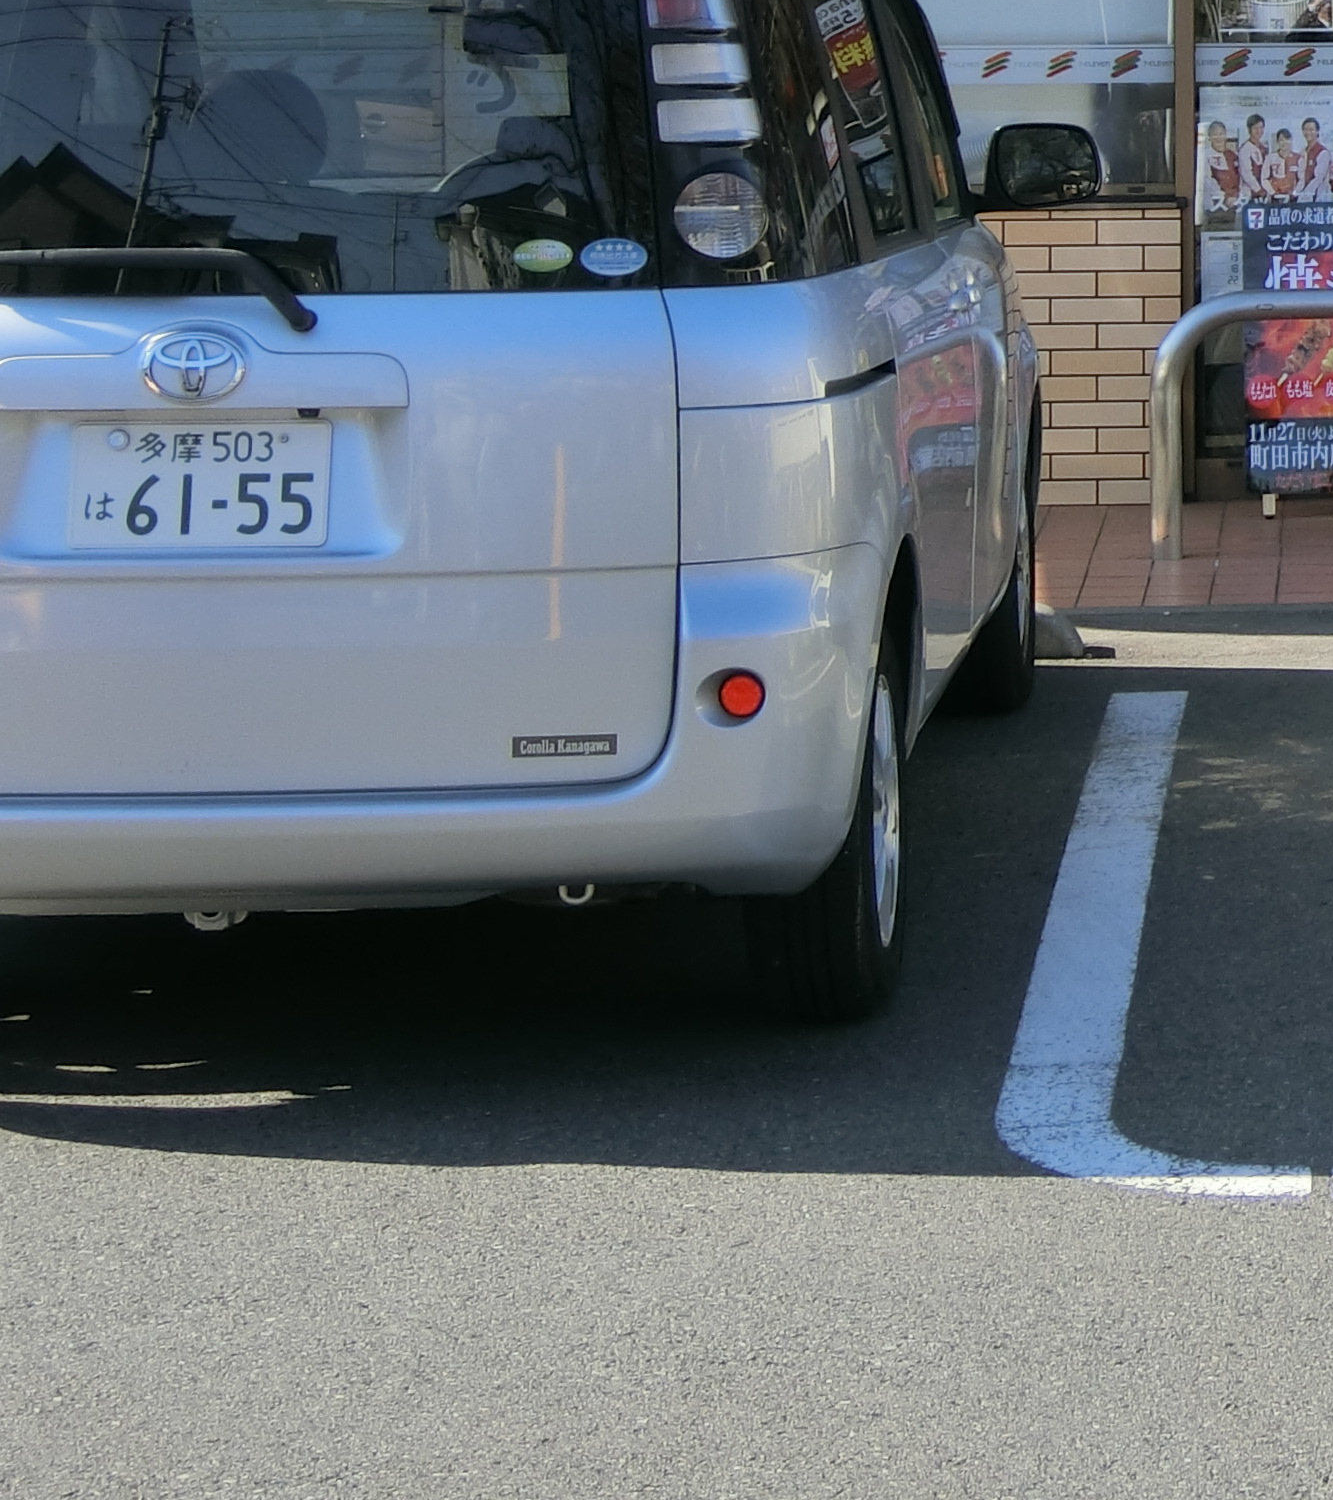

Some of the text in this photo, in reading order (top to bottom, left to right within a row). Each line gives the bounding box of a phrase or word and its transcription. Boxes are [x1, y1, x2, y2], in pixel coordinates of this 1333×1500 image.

[1250, 382, 1278, 399] ももたれ
[135, 431, 274, 463] 多摩 503
[84, 473, 315, 537] は 61-55
[520, 738, 610, 755] Corolla Kanagawa
